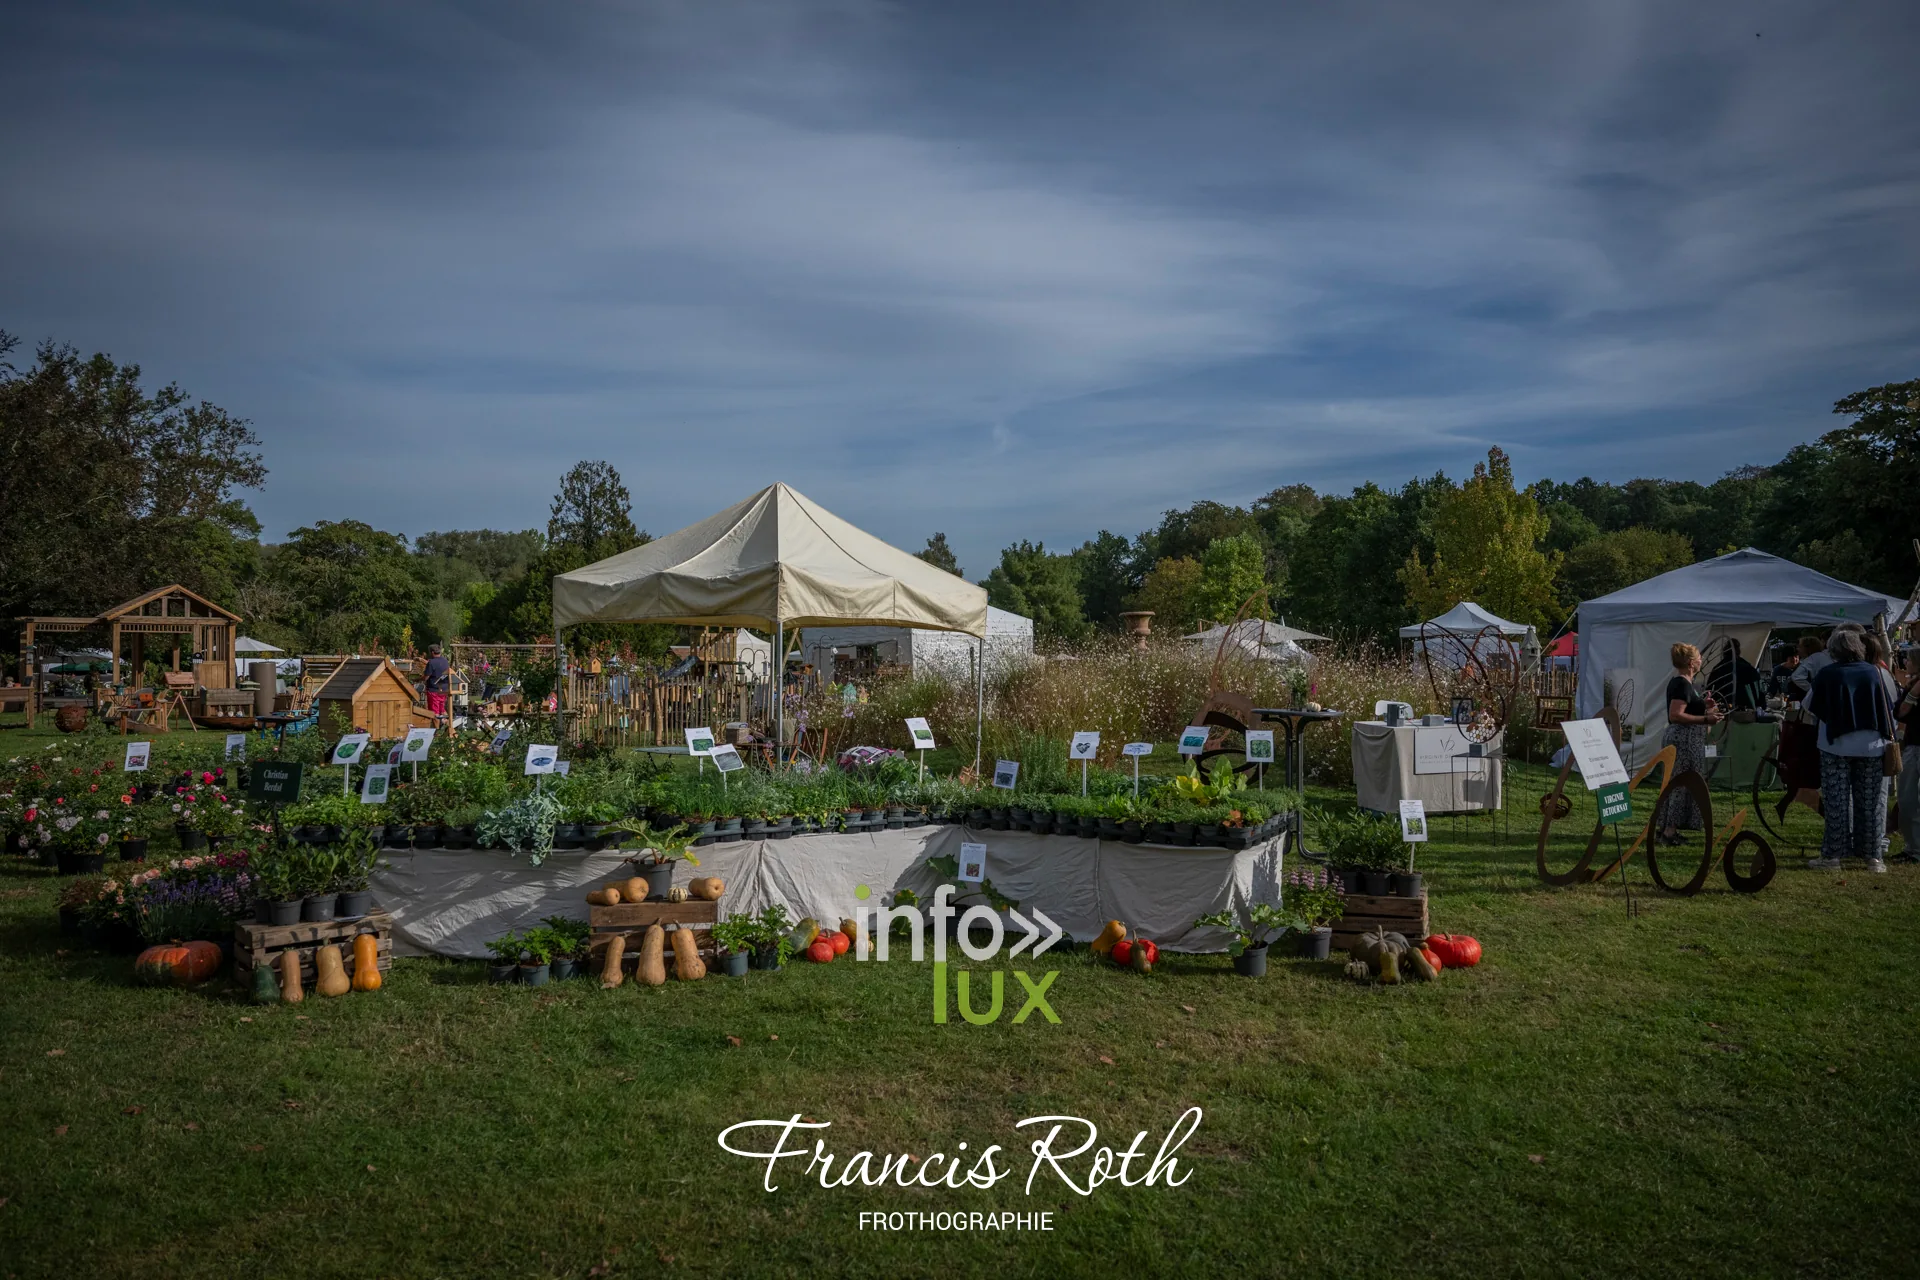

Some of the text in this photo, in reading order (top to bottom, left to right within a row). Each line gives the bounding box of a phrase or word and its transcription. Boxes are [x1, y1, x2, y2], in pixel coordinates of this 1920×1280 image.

[263, 769, 289, 780] Christian
[1604, 791, 1625, 805] VIRGINIE
[1602, 802, 1628, 817] DETOURNAY
